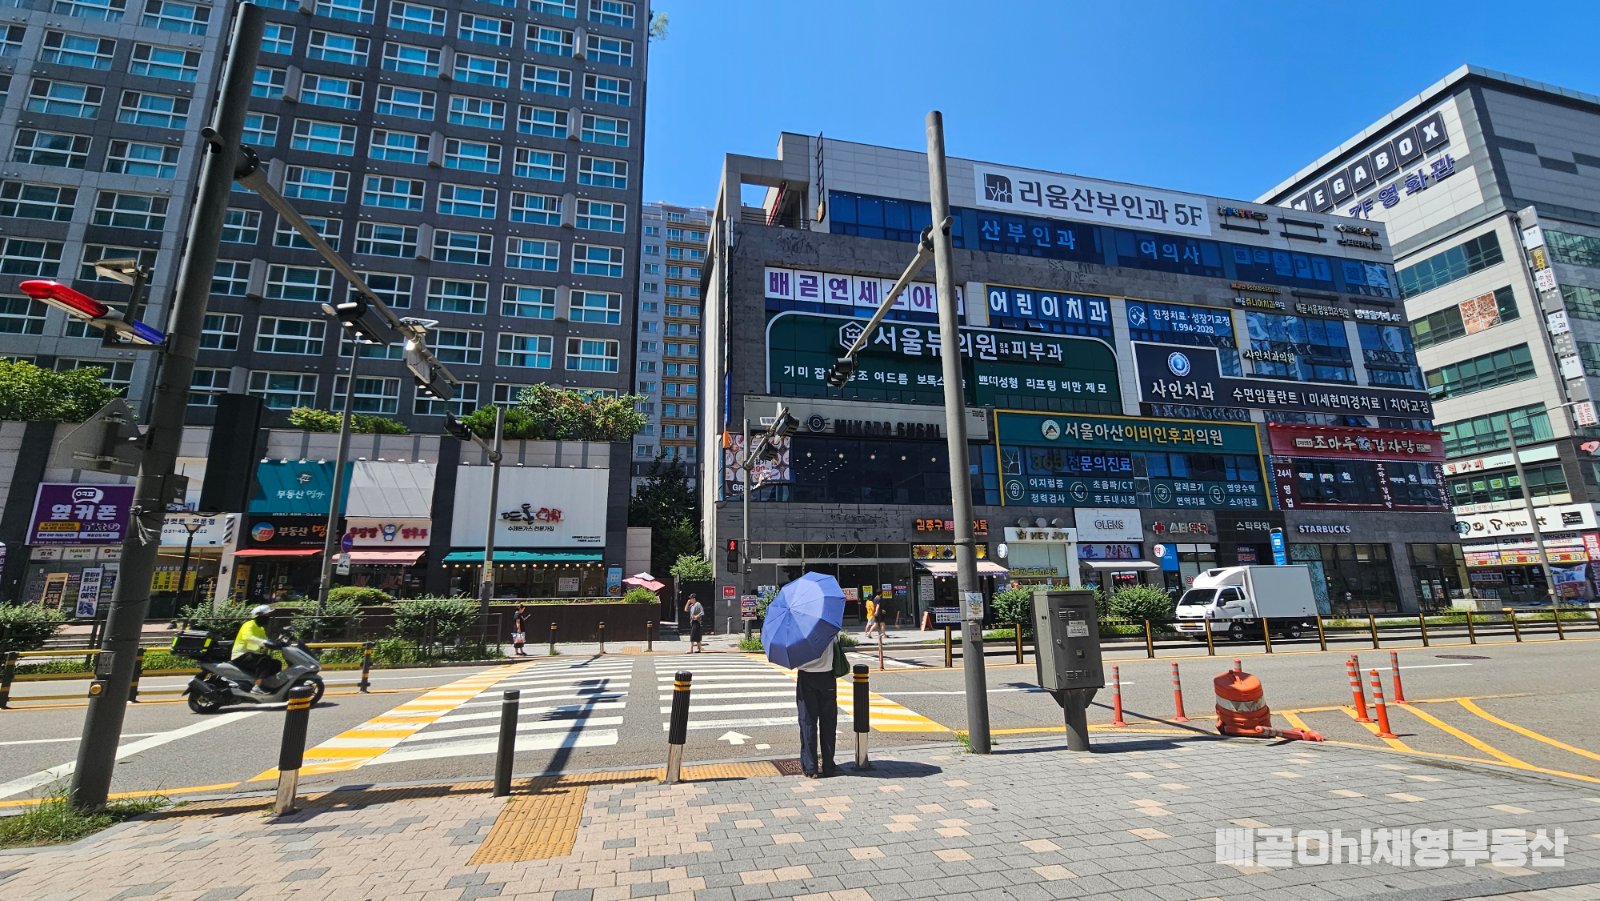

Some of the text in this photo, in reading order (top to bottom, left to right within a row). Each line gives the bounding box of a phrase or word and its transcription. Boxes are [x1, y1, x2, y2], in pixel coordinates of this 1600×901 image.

[1294, 121, 1440, 211] MEGABOX
[1376, 153, 1456, 210] 영화관
[1019, 180, 1168, 224] 리움산부인과
[1174, 203, 1203, 228] 5F
[981, 219, 1075, 251] 산부인과
[1140, 239, 1200, 265] 여의사
[769, 271, 960, 312] 배곧연세아
[989, 290, 1108, 323] 어린이치과
[1171, 322, 1215, 335] T.994-2028
[1011, 342, 1063, 362] 피부과
[1245, 350, 1296, 365] 샤인치과의원
[783, 365, 809, 378] 기미
[874, 371, 909, 385] 여드름
[917, 374, 945, 387] 보톡스
[978, 374, 1019, 390] 쁘띠성형
[1026, 378, 1057, 392] 리프팅
[1061, 380, 1082, 393] 비만
[1086, 382, 1108, 394] 제모
[1152, 379, 1215, 401] 샤인치과
[1232, 387, 1430, 414] 수면임플란트 미세현미경치료 치아교정
[834, 418, 941, 439] MIKADO SUSHI
[1065, 422, 1224, 446] 서울아산이비인후과의원
[1314, 435, 1356, 451] 조마루
[1371, 438, 1414, 454] 감자탕
[1068, 454, 1133, 472] 전문의진료
[1277, 468, 1293, 479] 24시
[1029, 478, 1064, 489] 어지럼증
[1092, 480, 1134, 491] 초음파/CT
[1174, 482, 1205, 492] 알레르기
[1226, 483, 1256, 493] 영양수액
[276, 489, 306, 500] 부동산
[1031, 493, 1066, 504] 청력검사
[1094, 494, 1136, 505] 후두내시경
[1176, 496, 1207, 507] 면역치료
[1229, 497, 1259, 508] 소아진료
[50, 504, 118, 520] 옆커폰
[278, 525, 309, 537] 부동산
[1169, 521, 1209, 535] 스타약국
[1236, 521, 1271, 531] 스타타워
[1298, 525, 1351, 534] STARBUCKS
[1505, 520, 1528, 528] WORLD
[1030, 531, 1070, 540] HEY JOY
